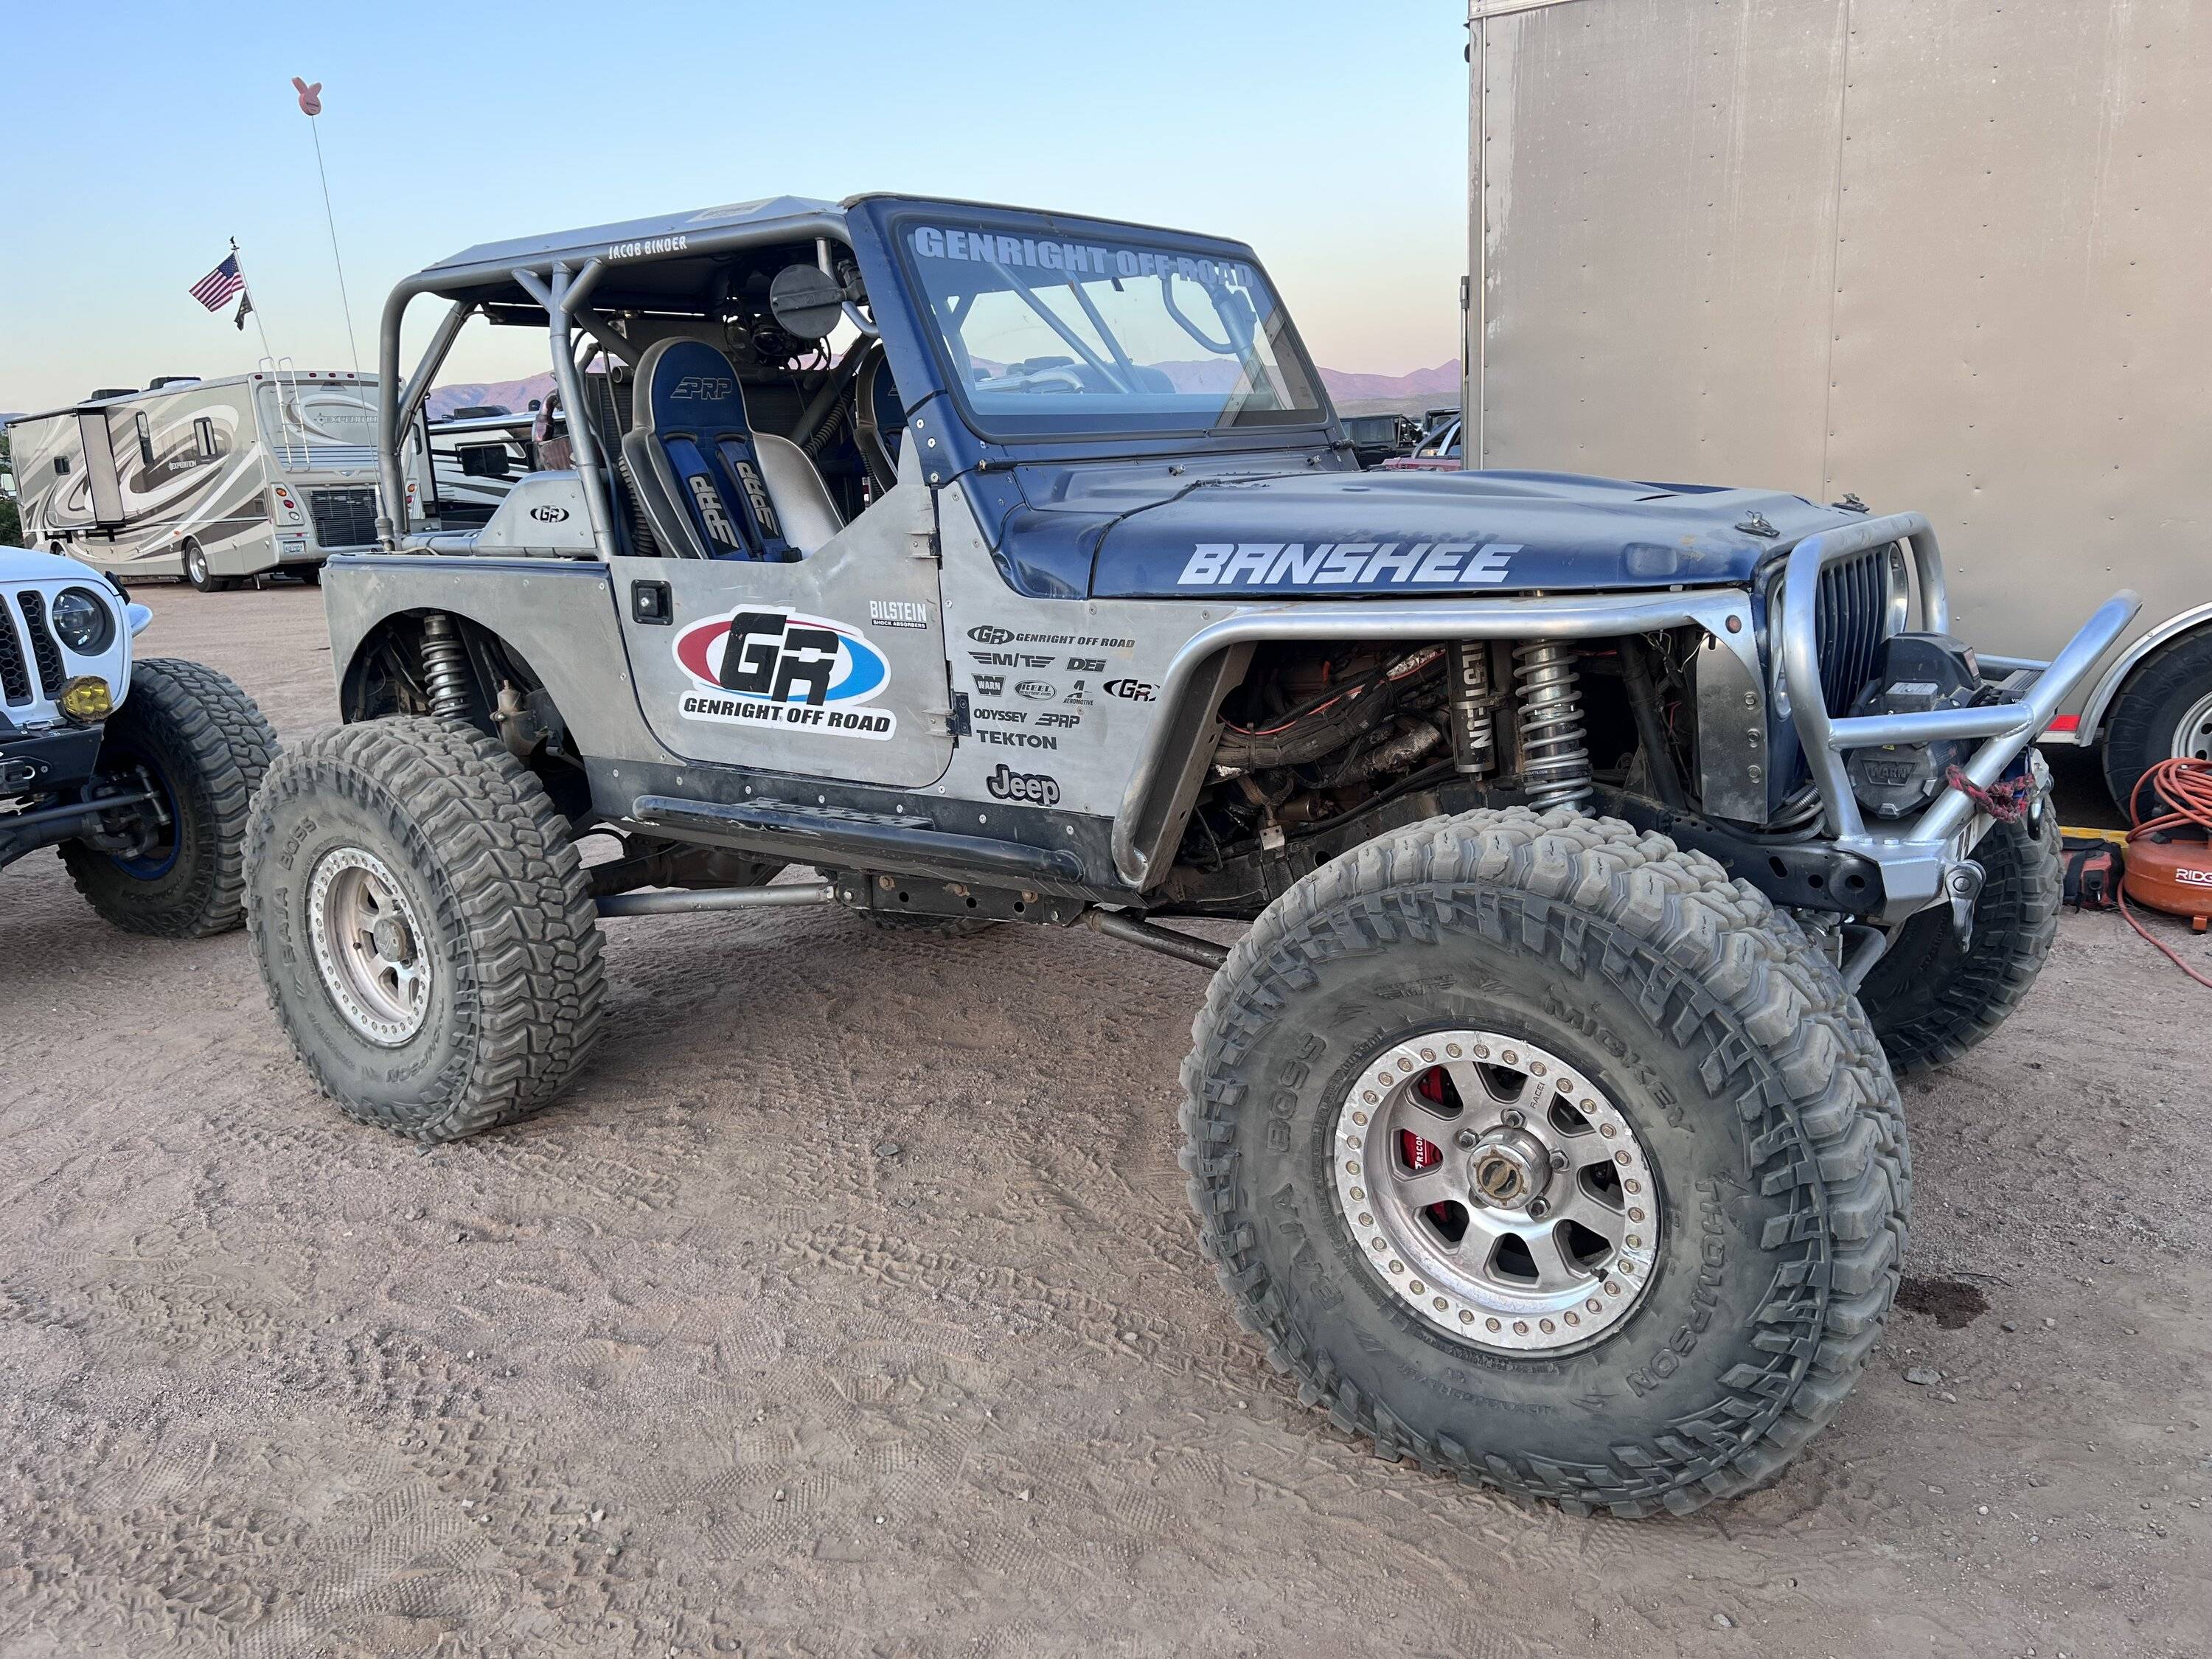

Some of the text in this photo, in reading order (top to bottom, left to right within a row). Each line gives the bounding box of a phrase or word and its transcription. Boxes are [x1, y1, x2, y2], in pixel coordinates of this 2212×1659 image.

[608, 235, 687, 260] JACOB BINDER
[914, 226, 1254, 288] GENRIGHT OFF ROAD
[669, 377, 732, 400] PRP
[689, 476, 739, 548] PRP
[737, 462, 779, 537] PRP
[1178, 543, 1525, 585] BANSHEE
[869, 600, 927, 622] BILSTEIN
[893, 621, 926, 629] ABSORBERS
[977, 625, 1135, 648] GR GENRIGHT OFF ROAD
[719, 612, 841, 706] GR
[977, 680, 1001, 692] WARN
[1062, 698, 1094, 706] AEROMOTIVE
[1118, 678, 1152, 702] GR
[1461, 639, 1493, 749] ILSTIN
[684, 698, 891, 733] GENRIGHT OFF ROAD
[973, 708, 1080, 728] ODYSSEY PRP
[976, 729, 1057, 751] TEKTON
[992, 768, 1060, 805] Jeep
[1868, 766, 1907, 779] WARN
[280, 816, 317, 871] BOSS
[275, 887, 296, 964] BAJA
[1267, 1032, 1326, 1152] BOSS
[1545, 994, 1725, 1397] MICKEY THOMPSON
[1271, 1183, 1344, 1310] BAJA
